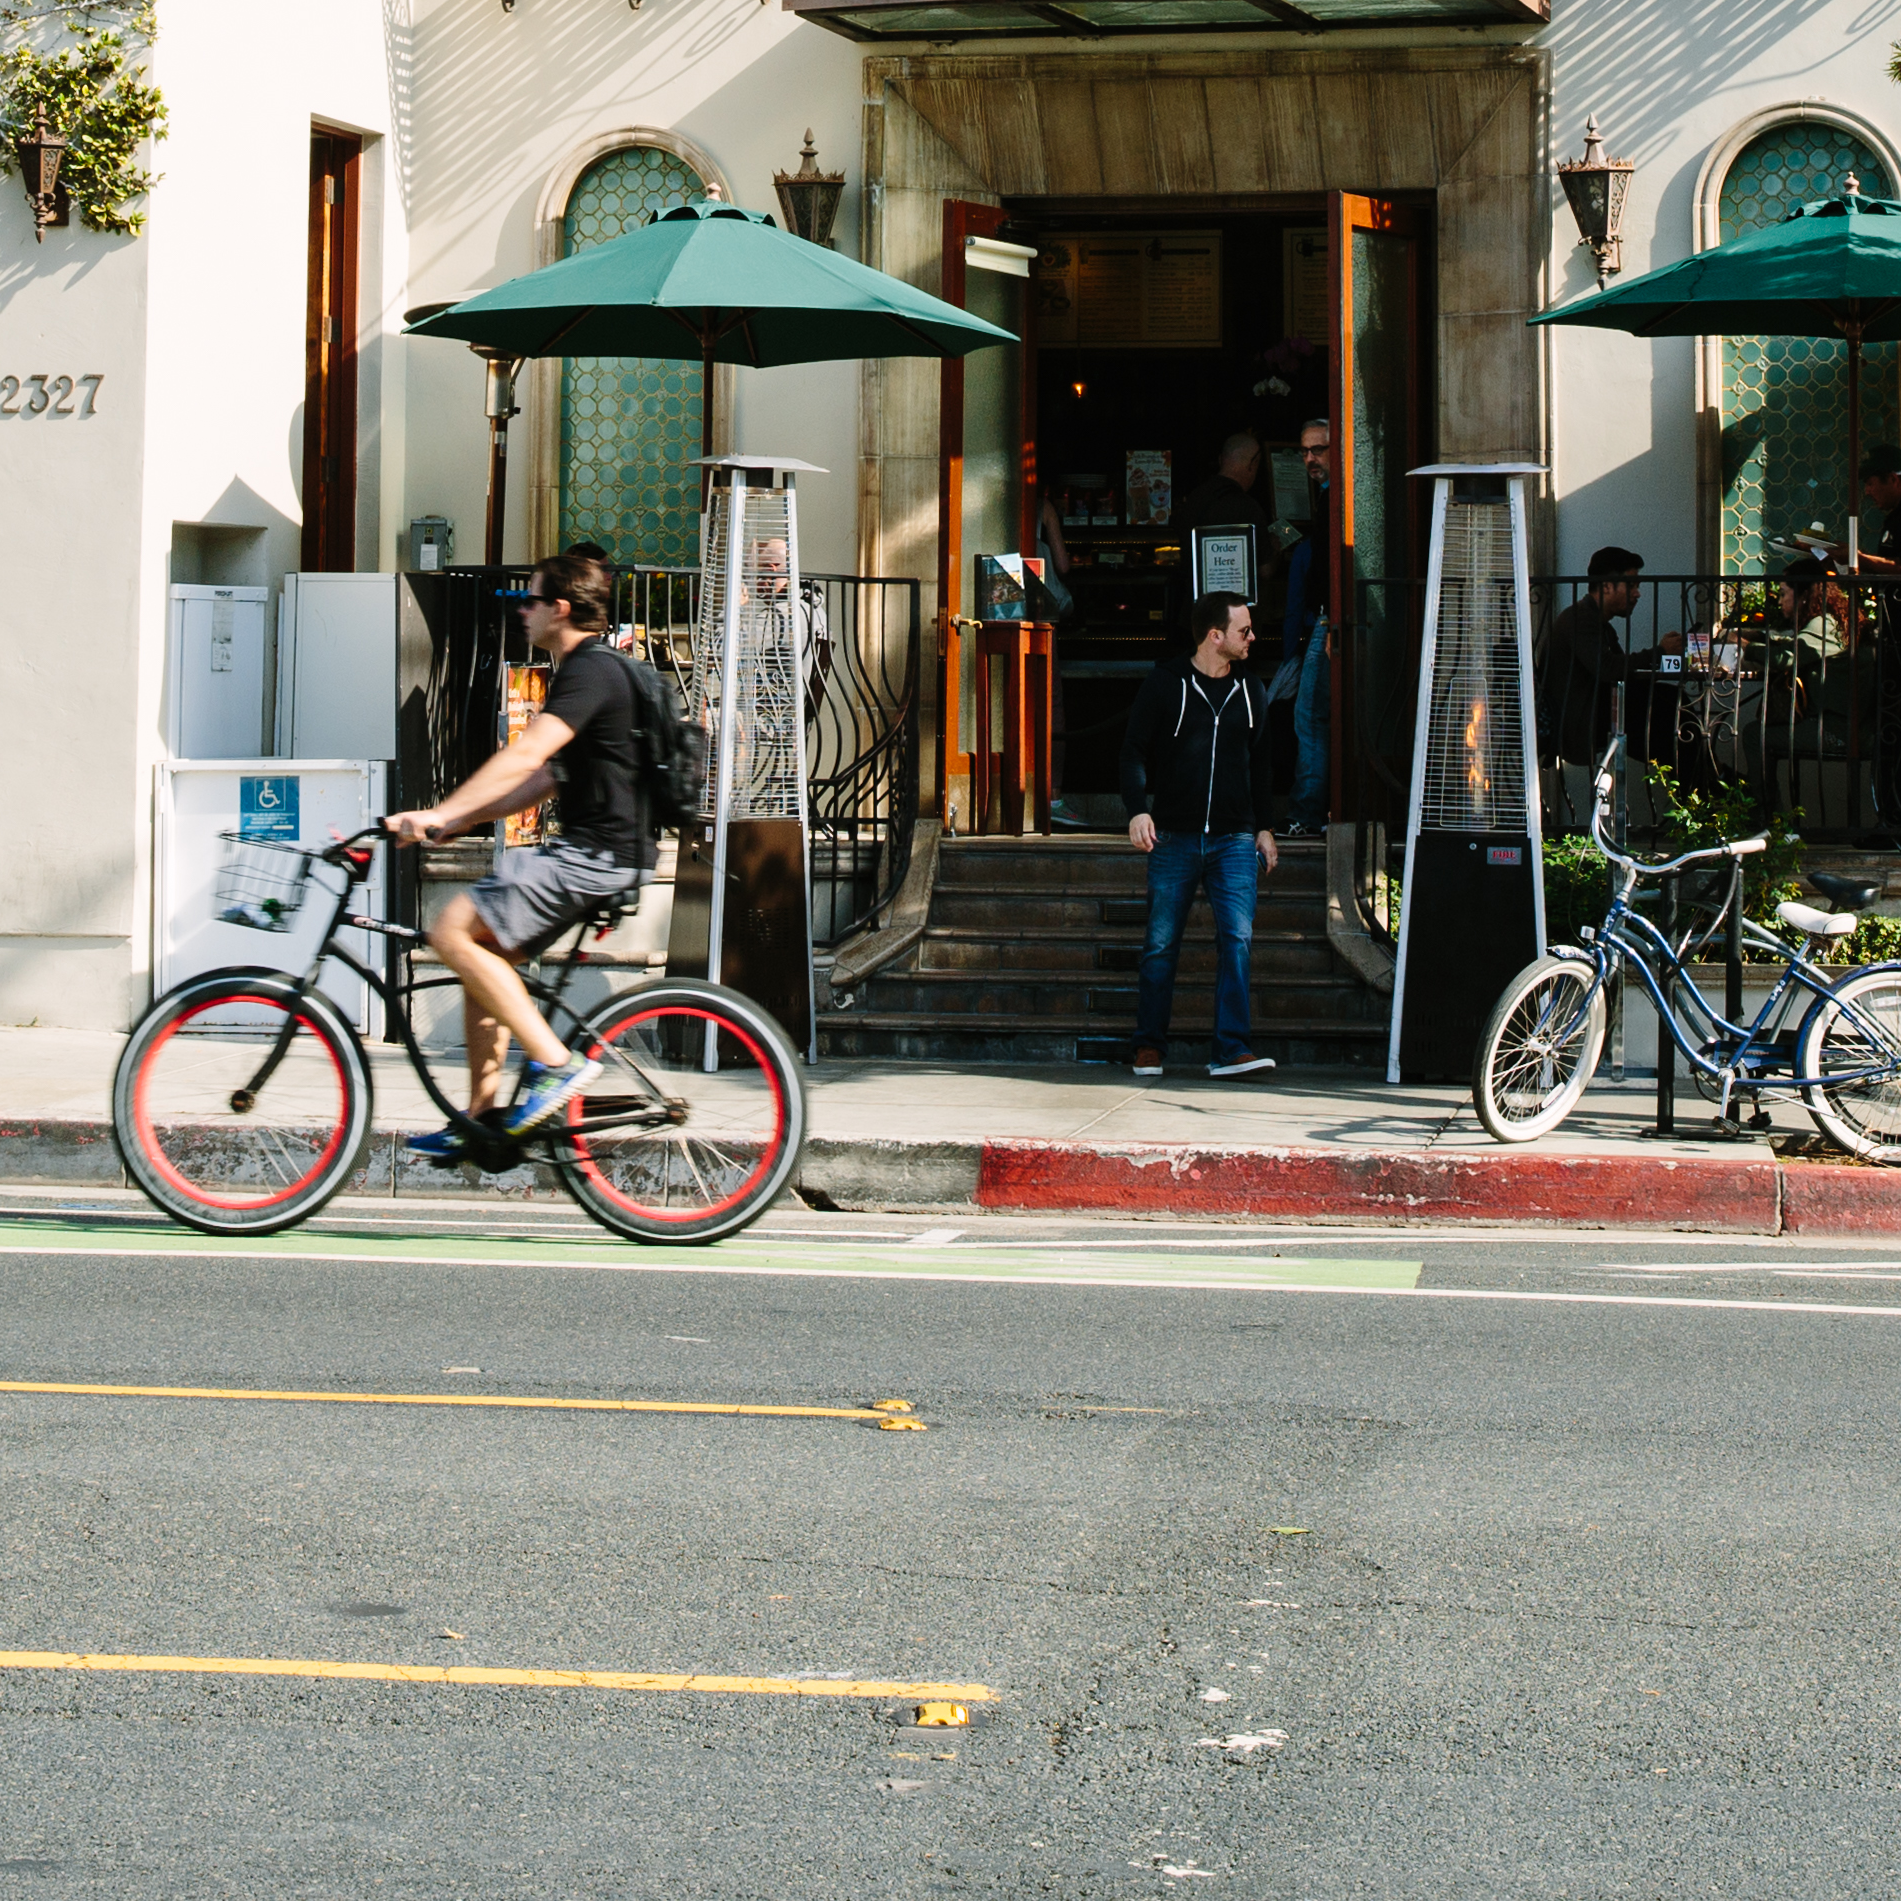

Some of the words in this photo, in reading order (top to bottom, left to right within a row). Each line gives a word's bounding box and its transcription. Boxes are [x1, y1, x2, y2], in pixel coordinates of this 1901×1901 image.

[2, 374, 104, 414] 2327
[1211, 543, 1238, 553] Order
[1214, 557, 1236, 566] Here
[1665, 658, 1680, 670] 79
